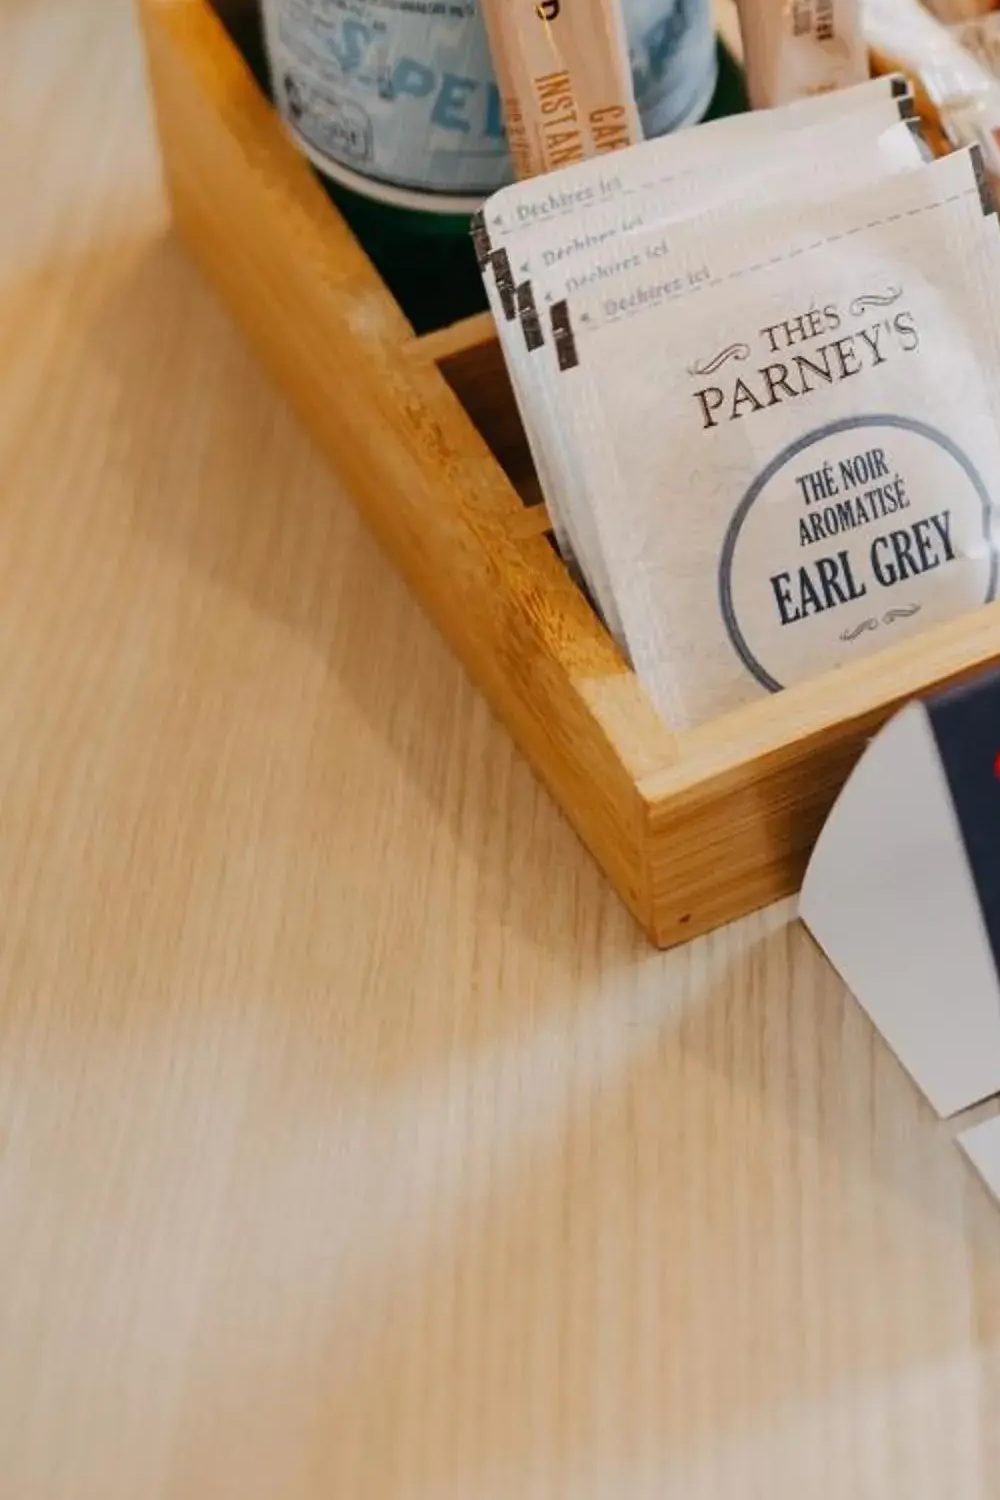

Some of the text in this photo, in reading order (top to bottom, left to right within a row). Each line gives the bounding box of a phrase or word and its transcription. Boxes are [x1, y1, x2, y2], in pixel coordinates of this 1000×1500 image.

[760, 299, 841, 352] THÉS
[693, 312, 919, 429] PARNEY'S
[795, 448, 889, 506] THÉ NOIR
[799, 474, 911, 547] AROMATISÉ
[770, 510, 958, 626] EARL GREY
